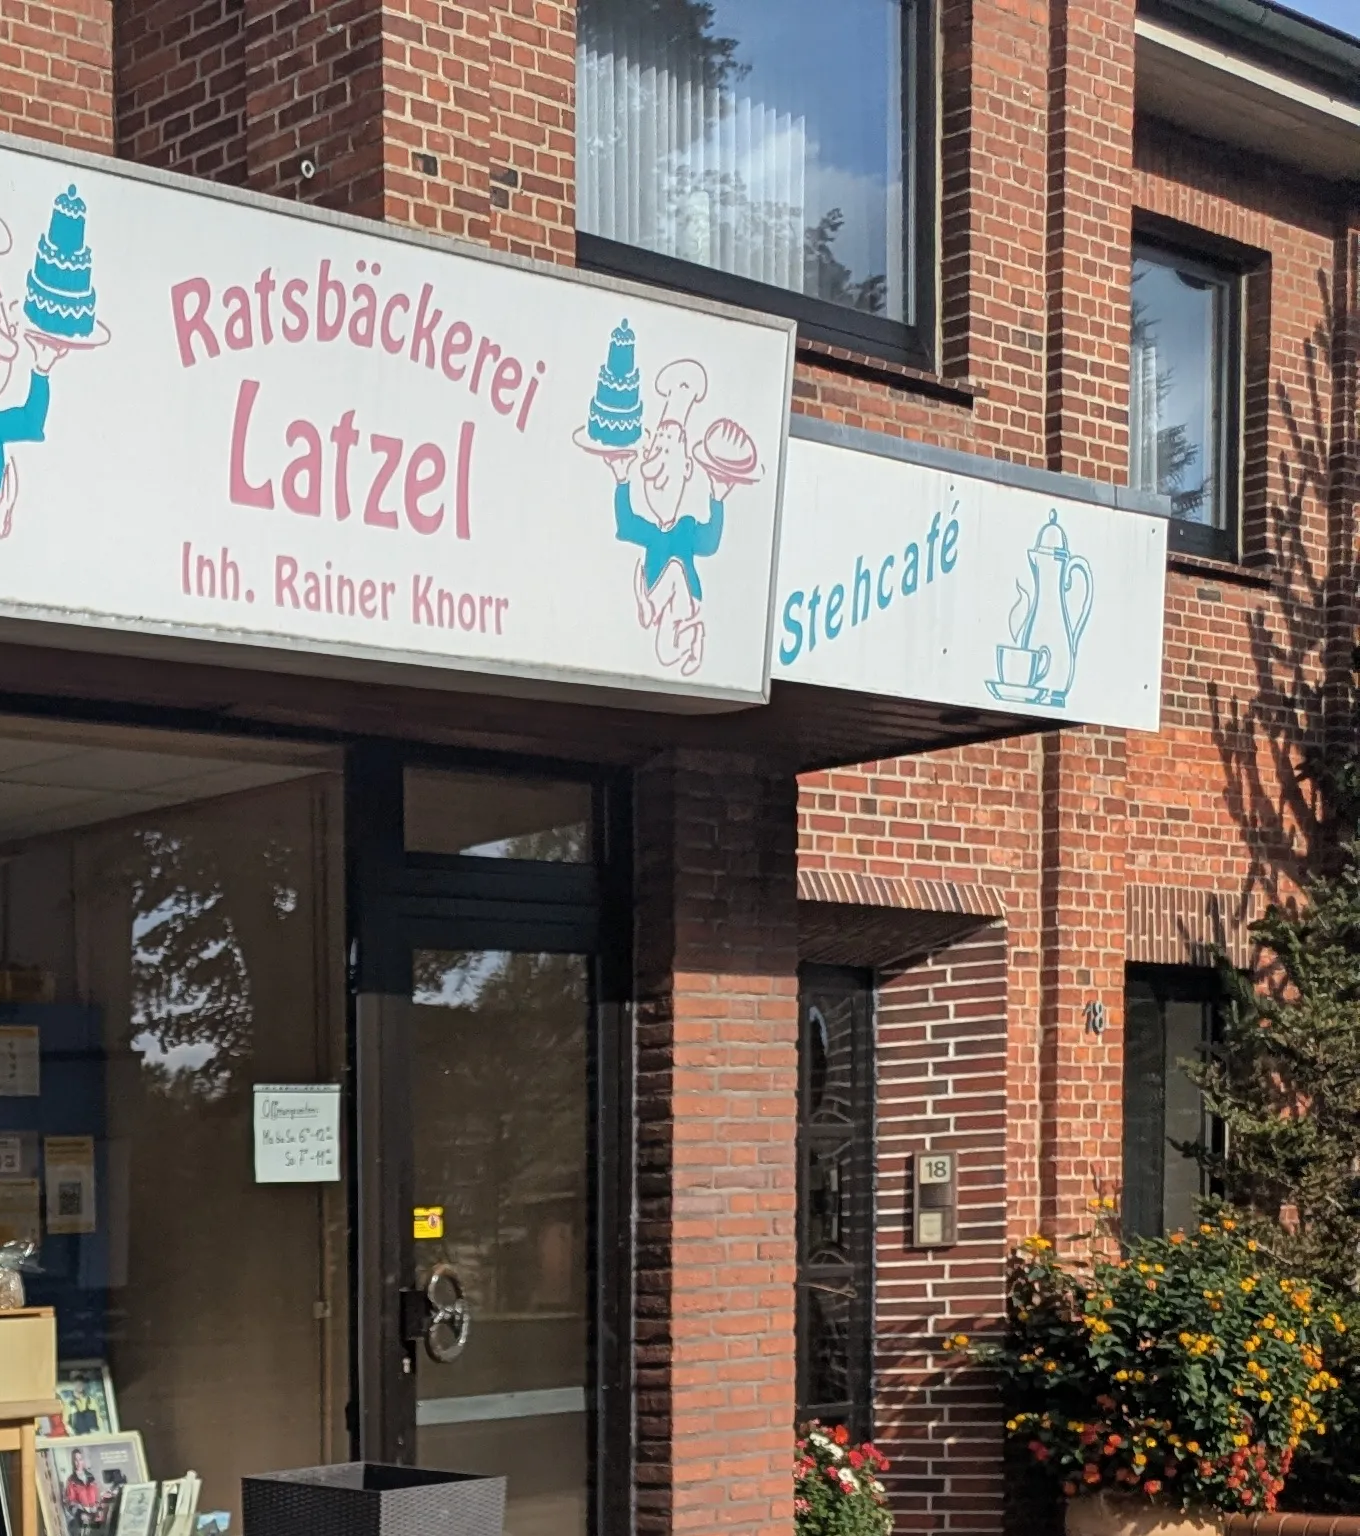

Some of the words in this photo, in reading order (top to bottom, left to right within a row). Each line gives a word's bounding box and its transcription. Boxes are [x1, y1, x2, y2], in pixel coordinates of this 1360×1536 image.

[170, 259, 547, 433] Ratsbäckerei
[229, 379, 475, 540] Latzel
[181, 541, 255, 603] Inh.
[275, 554, 395, 621] Rainer
[412, 574, 509, 635] Knorr
[779, 500, 959, 665] Stehcafé
[1082, 1000, 1106, 1034] 18
[925, 1161, 947, 1178] 18
